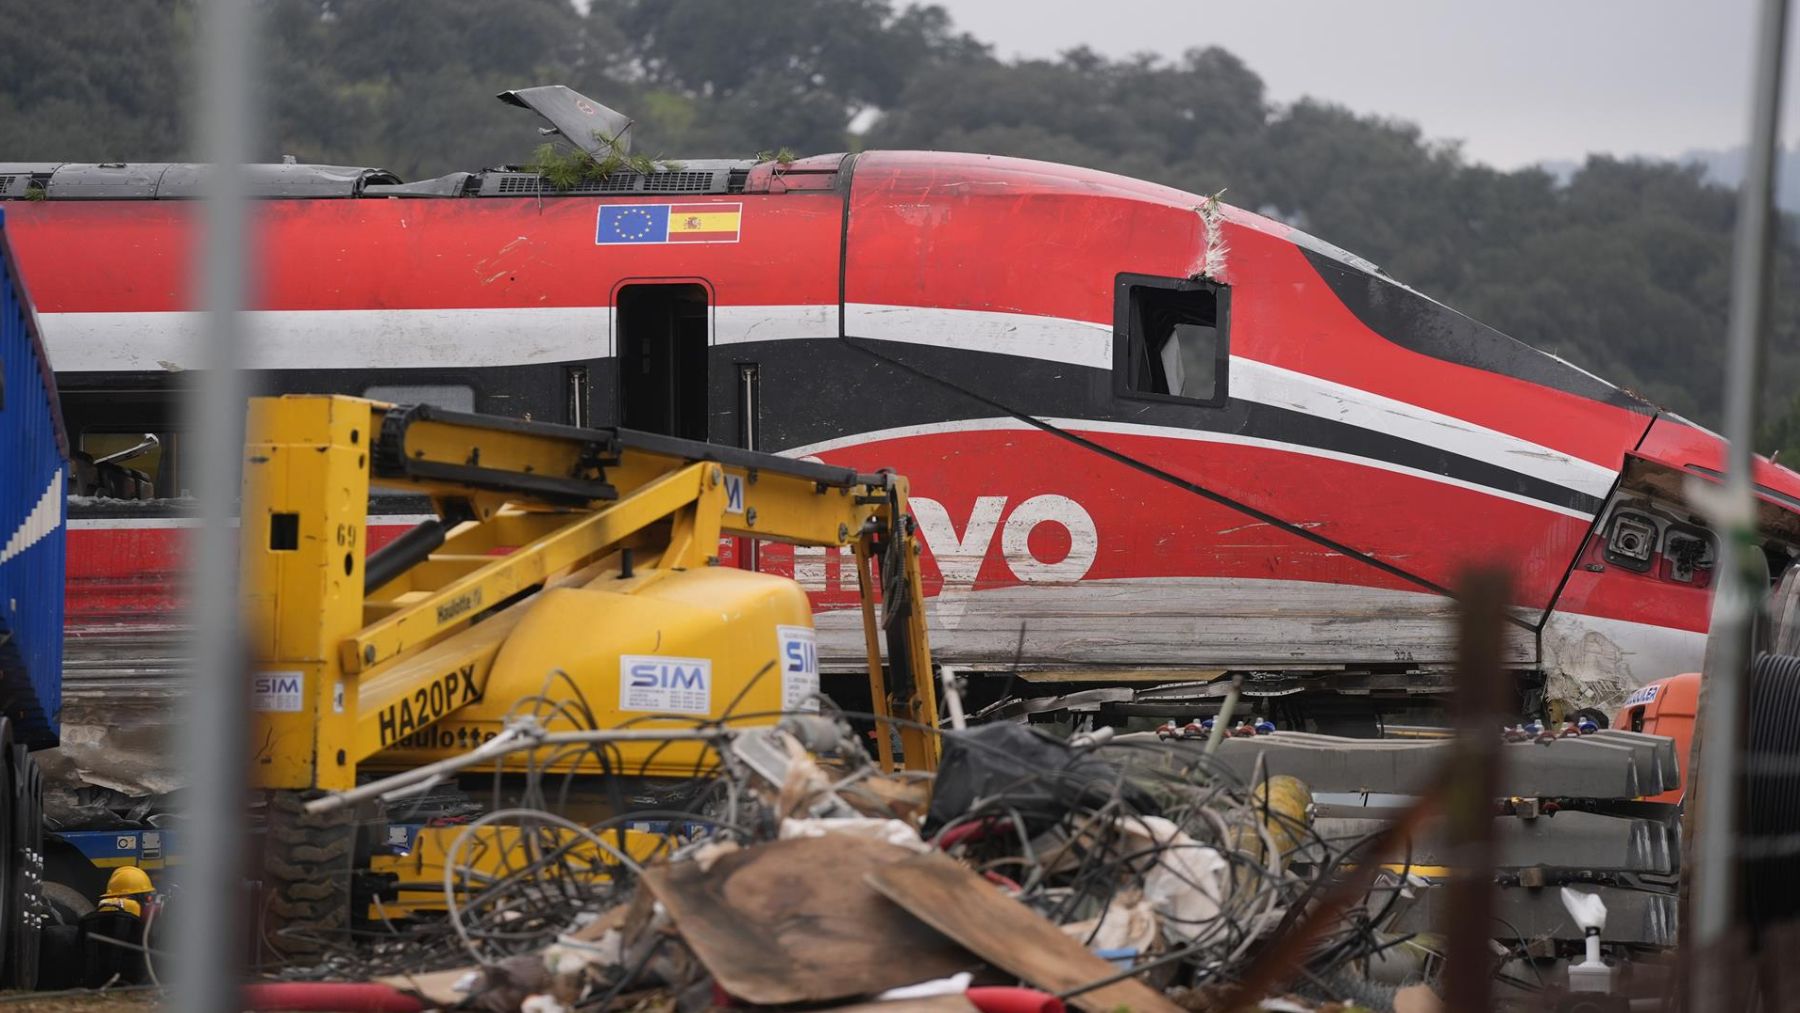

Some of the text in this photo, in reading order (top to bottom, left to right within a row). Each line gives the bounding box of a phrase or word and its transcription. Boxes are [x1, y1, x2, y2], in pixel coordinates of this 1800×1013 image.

[255, 678, 299, 694] SIM
[630, 664, 706, 690] SIM
[378, 663, 481, 746] HA20PX
